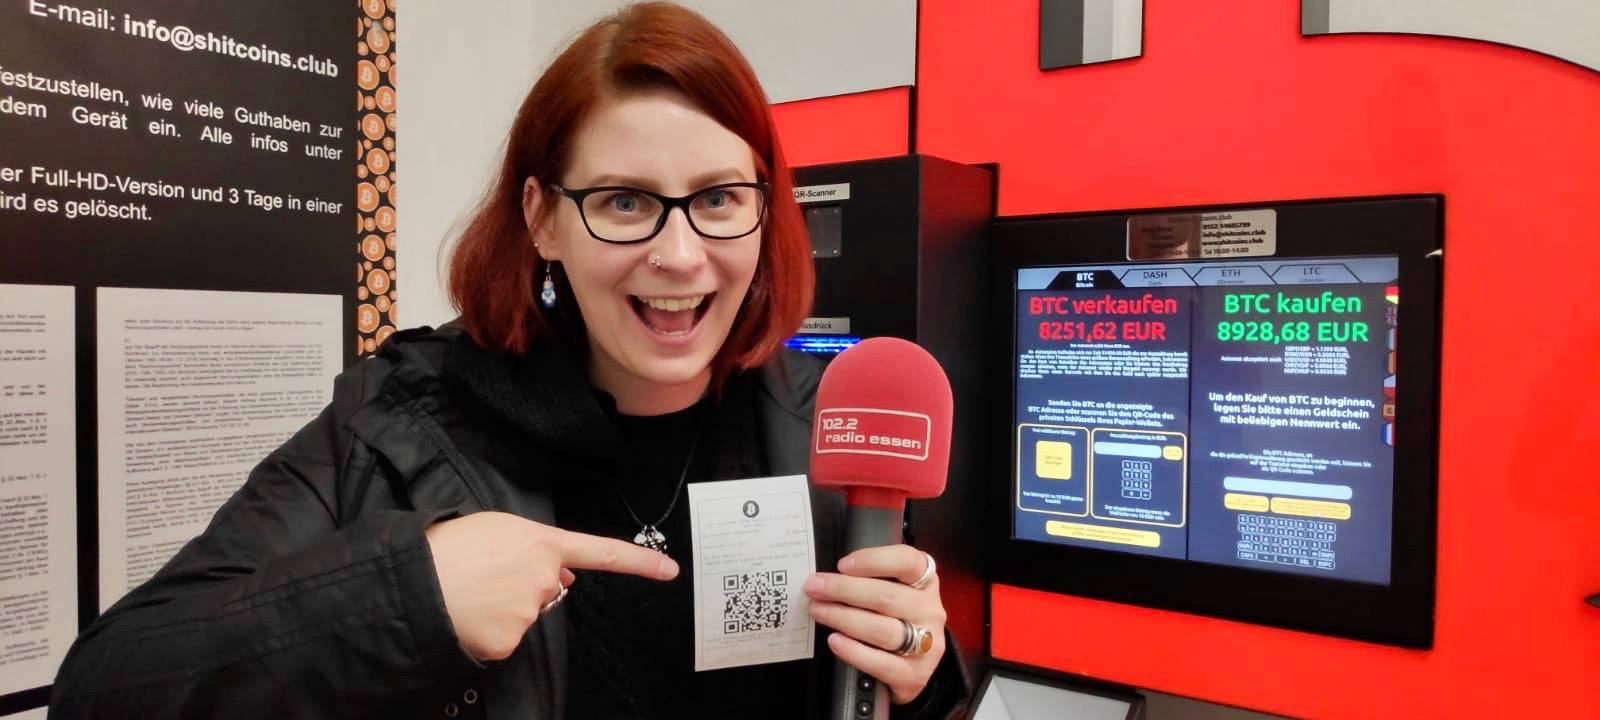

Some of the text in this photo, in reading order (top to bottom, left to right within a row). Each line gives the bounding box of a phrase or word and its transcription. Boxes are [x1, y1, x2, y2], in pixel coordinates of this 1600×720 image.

[30, 0, 339, 78] E-mail: info@shitcoins.club
[142, 95, 173, 112] wie
[184, 100, 225, 119] viele
[234, 107, 311, 134] Guthaben
[319, 124, 343, 139] zur
[0, 96, 343, 161] dem Gerät ein. Alle infos unter
[31, 166, 185, 199] Full-HD-Version
[191, 187, 224, 203] und
[228, 188, 240, 204] 3
[244, 190, 283, 210] Tage
[288, 195, 301, 209] in
[305, 198, 343, 214] einer
[794, 189, 837, 199] QR-Scanner
[33, 198, 59, 213] es
[65, 197, 152, 222] gelöscht.
[1076, 267, 1321, 281] BTC DASH ETH LTC
[1029, 293, 1178, 315] BTC verkaufen
[1224, 291, 1362, 314] BTC kaufen
[1039, 321, 1166, 342] 8251,62 EUR
[1217, 321, 1369, 345] 8928,68 EUR
[1082, 400, 1096, 408] BTC
[1209, 392, 1375, 408] Um den Kauf von BTC zu beginnen,
[1213, 402, 1370, 419] legen Sie bitte einen Geldschein
[822, 417, 858, 431] 102.2
[1220, 414, 1361, 430] mit beliebigen Nennwert ein.
[825, 432, 921, 449] radio essen
